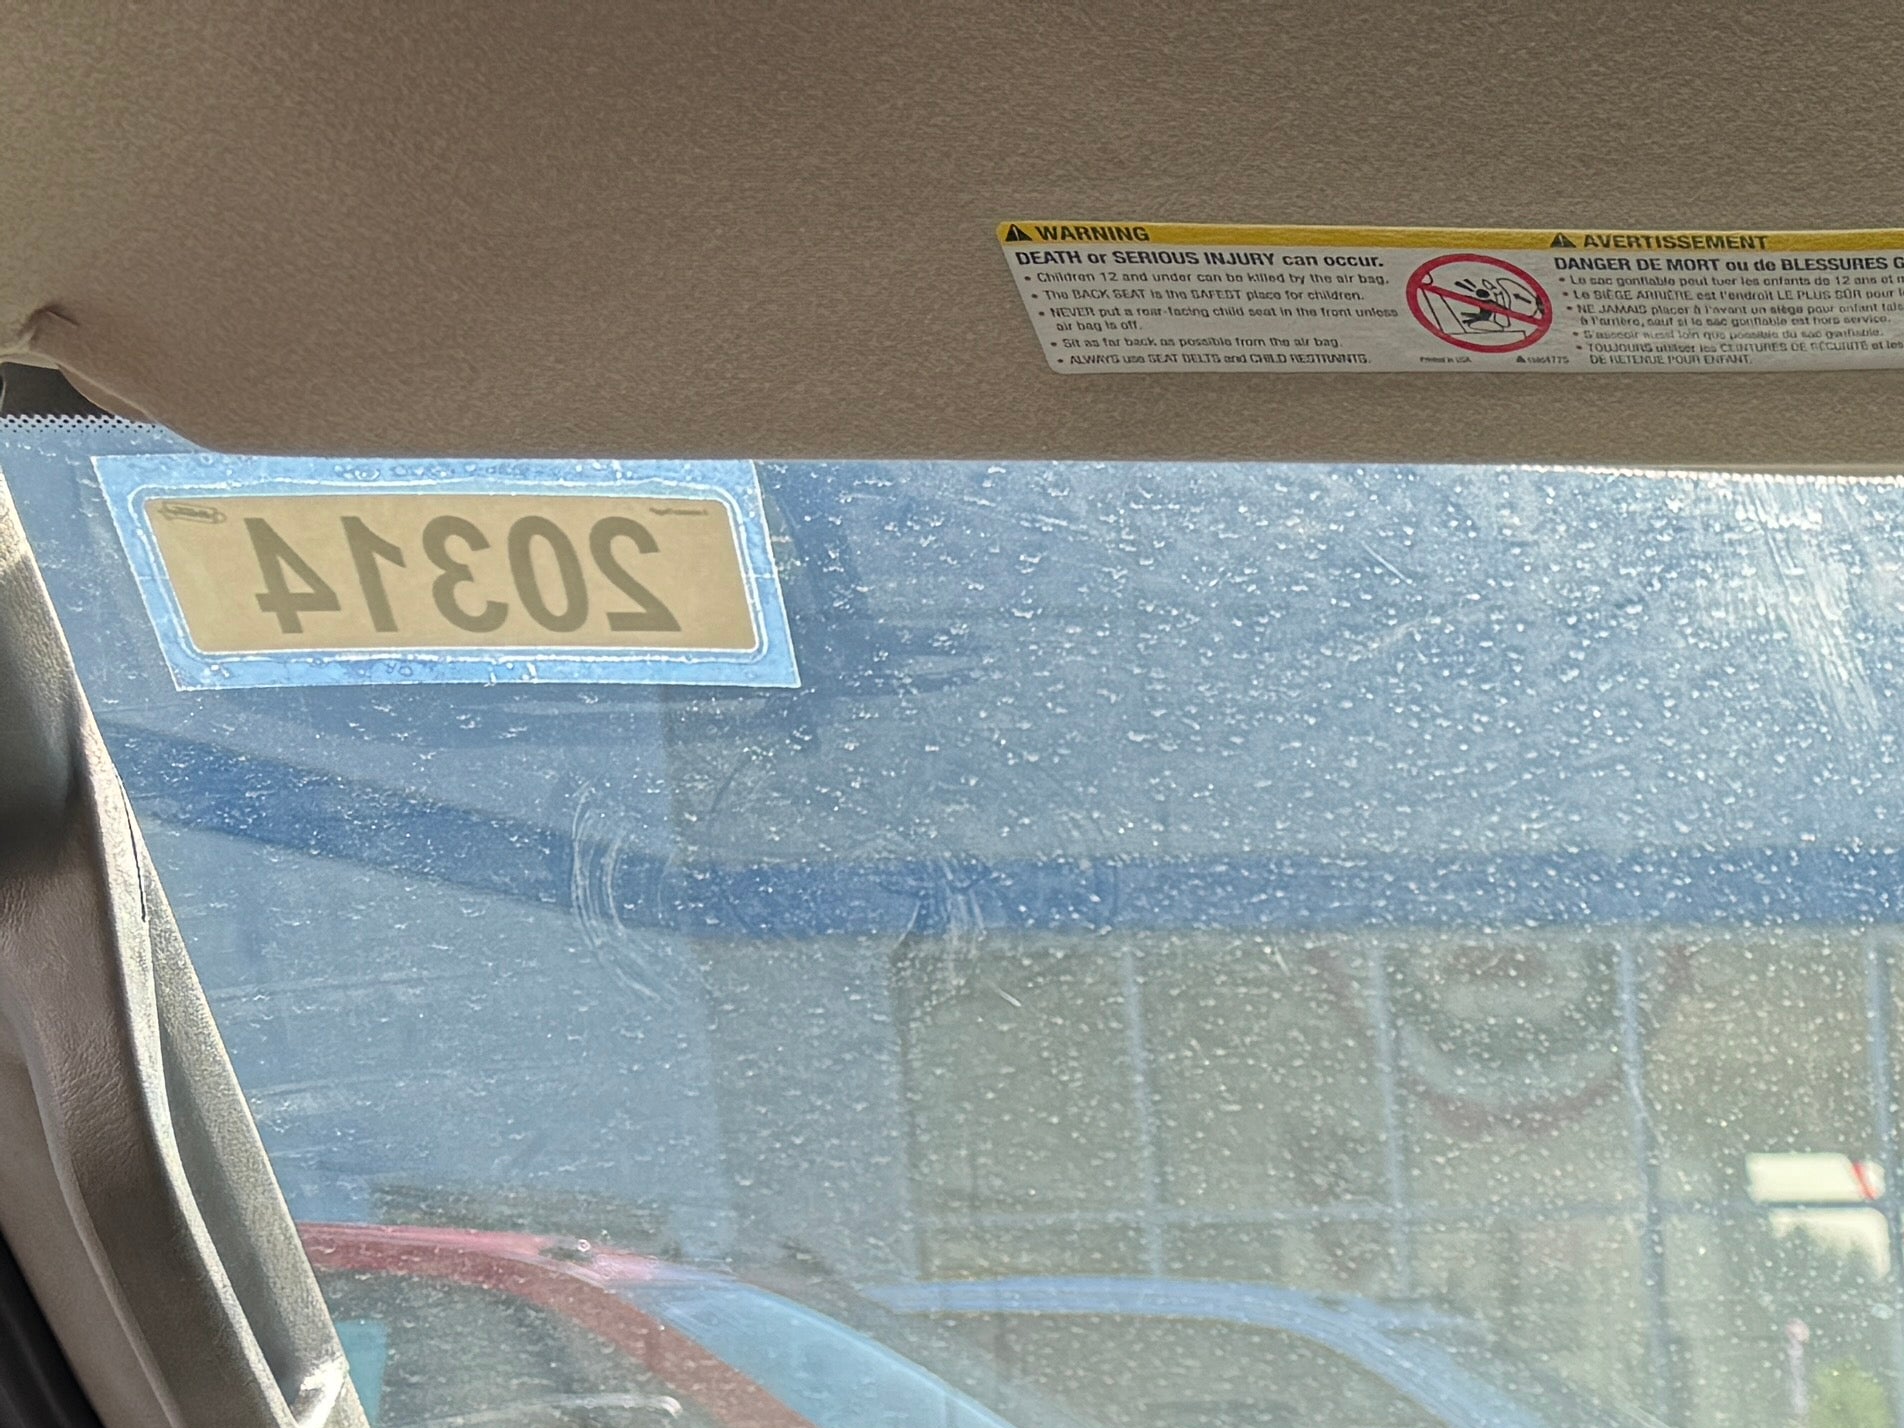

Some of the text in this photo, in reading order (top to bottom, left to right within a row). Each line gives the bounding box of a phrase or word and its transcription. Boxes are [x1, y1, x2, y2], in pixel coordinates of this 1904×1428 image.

[1035, 226, 1149, 241] WARNING
[1584, 235, 1767, 249] AVERTISSEMENT
[1016, 251, 1384, 267] DEATH or SERIOUS INJURY can occur.
[1555, 257, 1632, 271] DANGER
[1637, 258, 1661, 271] DE
[1667, 259, 1720, 271] MORT
[1726, 260, 1749, 271] ou
[1754, 259, 1776, 271] de
[1782, 257, 1888, 271] BLESSURES
[1037, 273, 1389, 285] Children 12 and under can be killed by the air bag.
